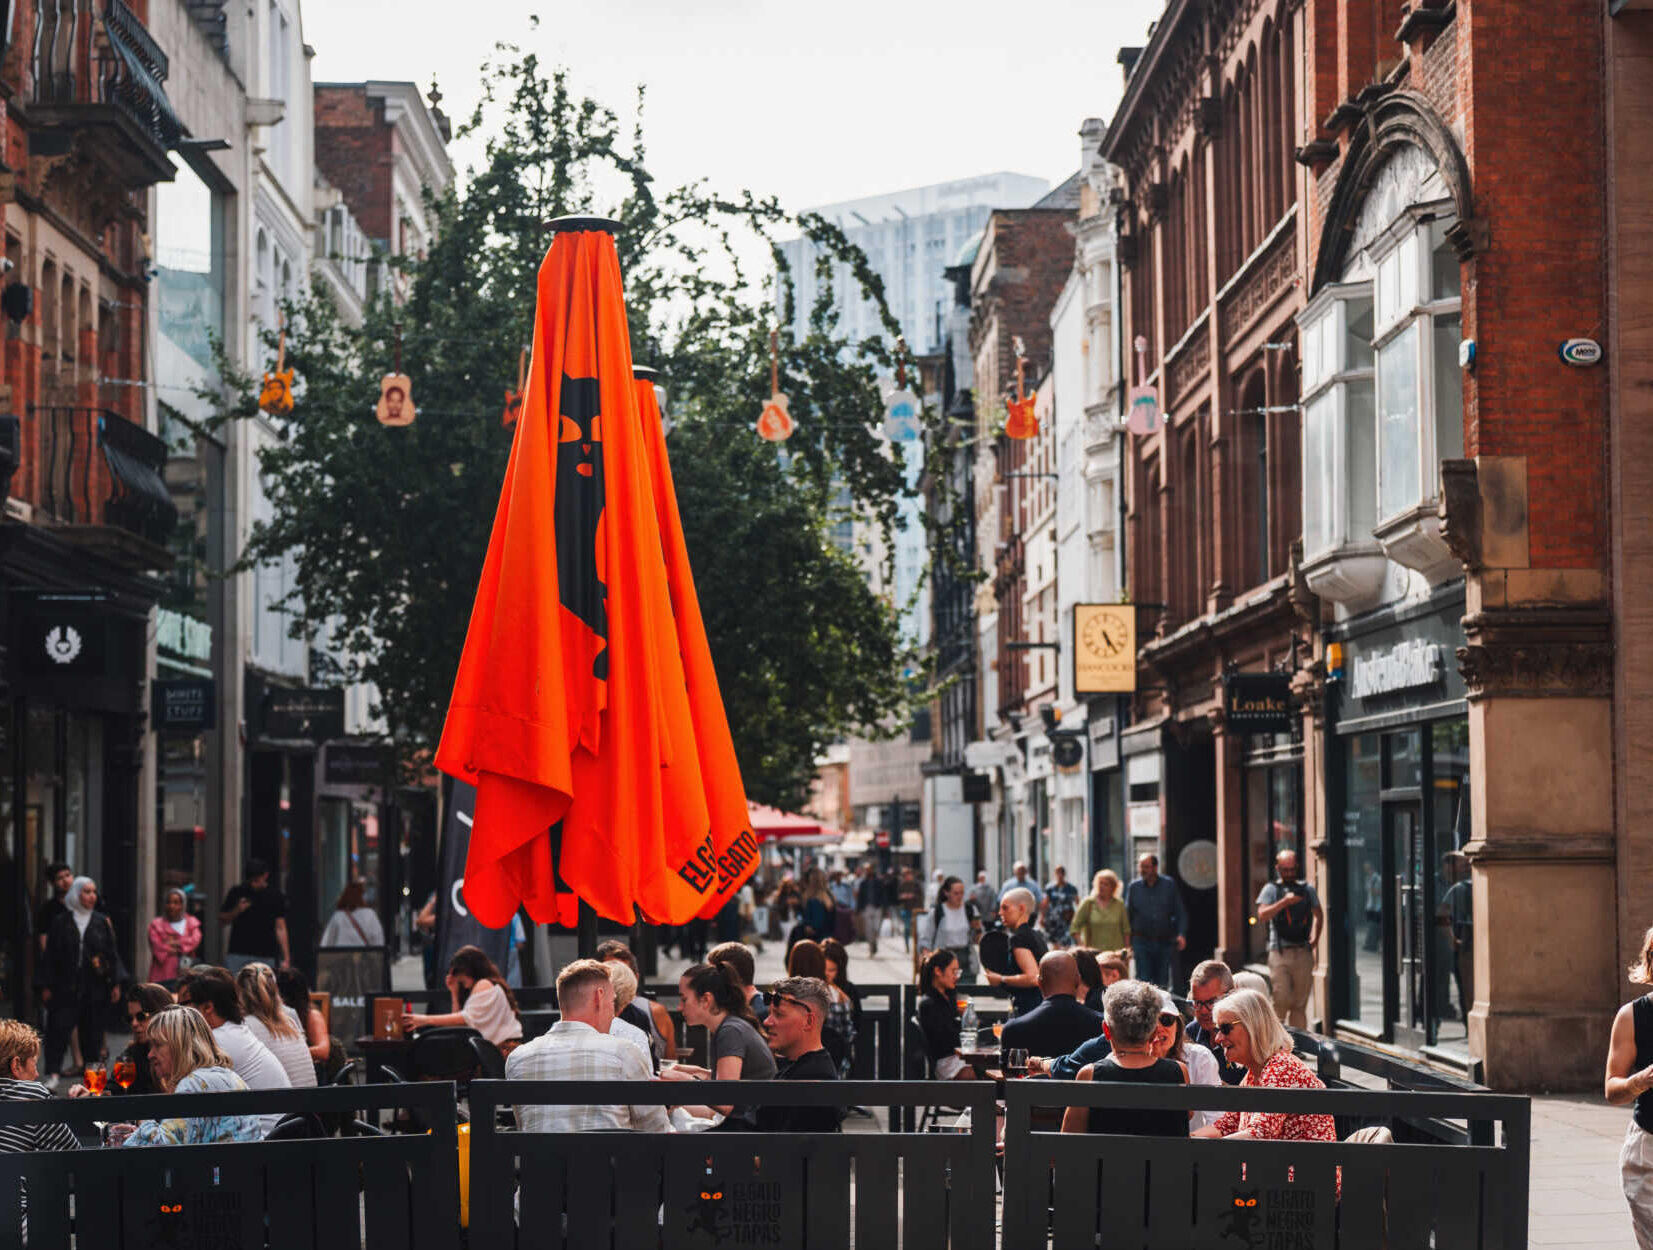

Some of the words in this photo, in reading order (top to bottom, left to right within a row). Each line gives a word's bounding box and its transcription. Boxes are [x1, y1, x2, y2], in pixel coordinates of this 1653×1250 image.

[1231, 696, 1286, 712] Loake
[332, 996, 366, 1007] SALE
[732, 1203, 781, 1223] NEGRO
[732, 1223, 781, 1244] TAPAS
